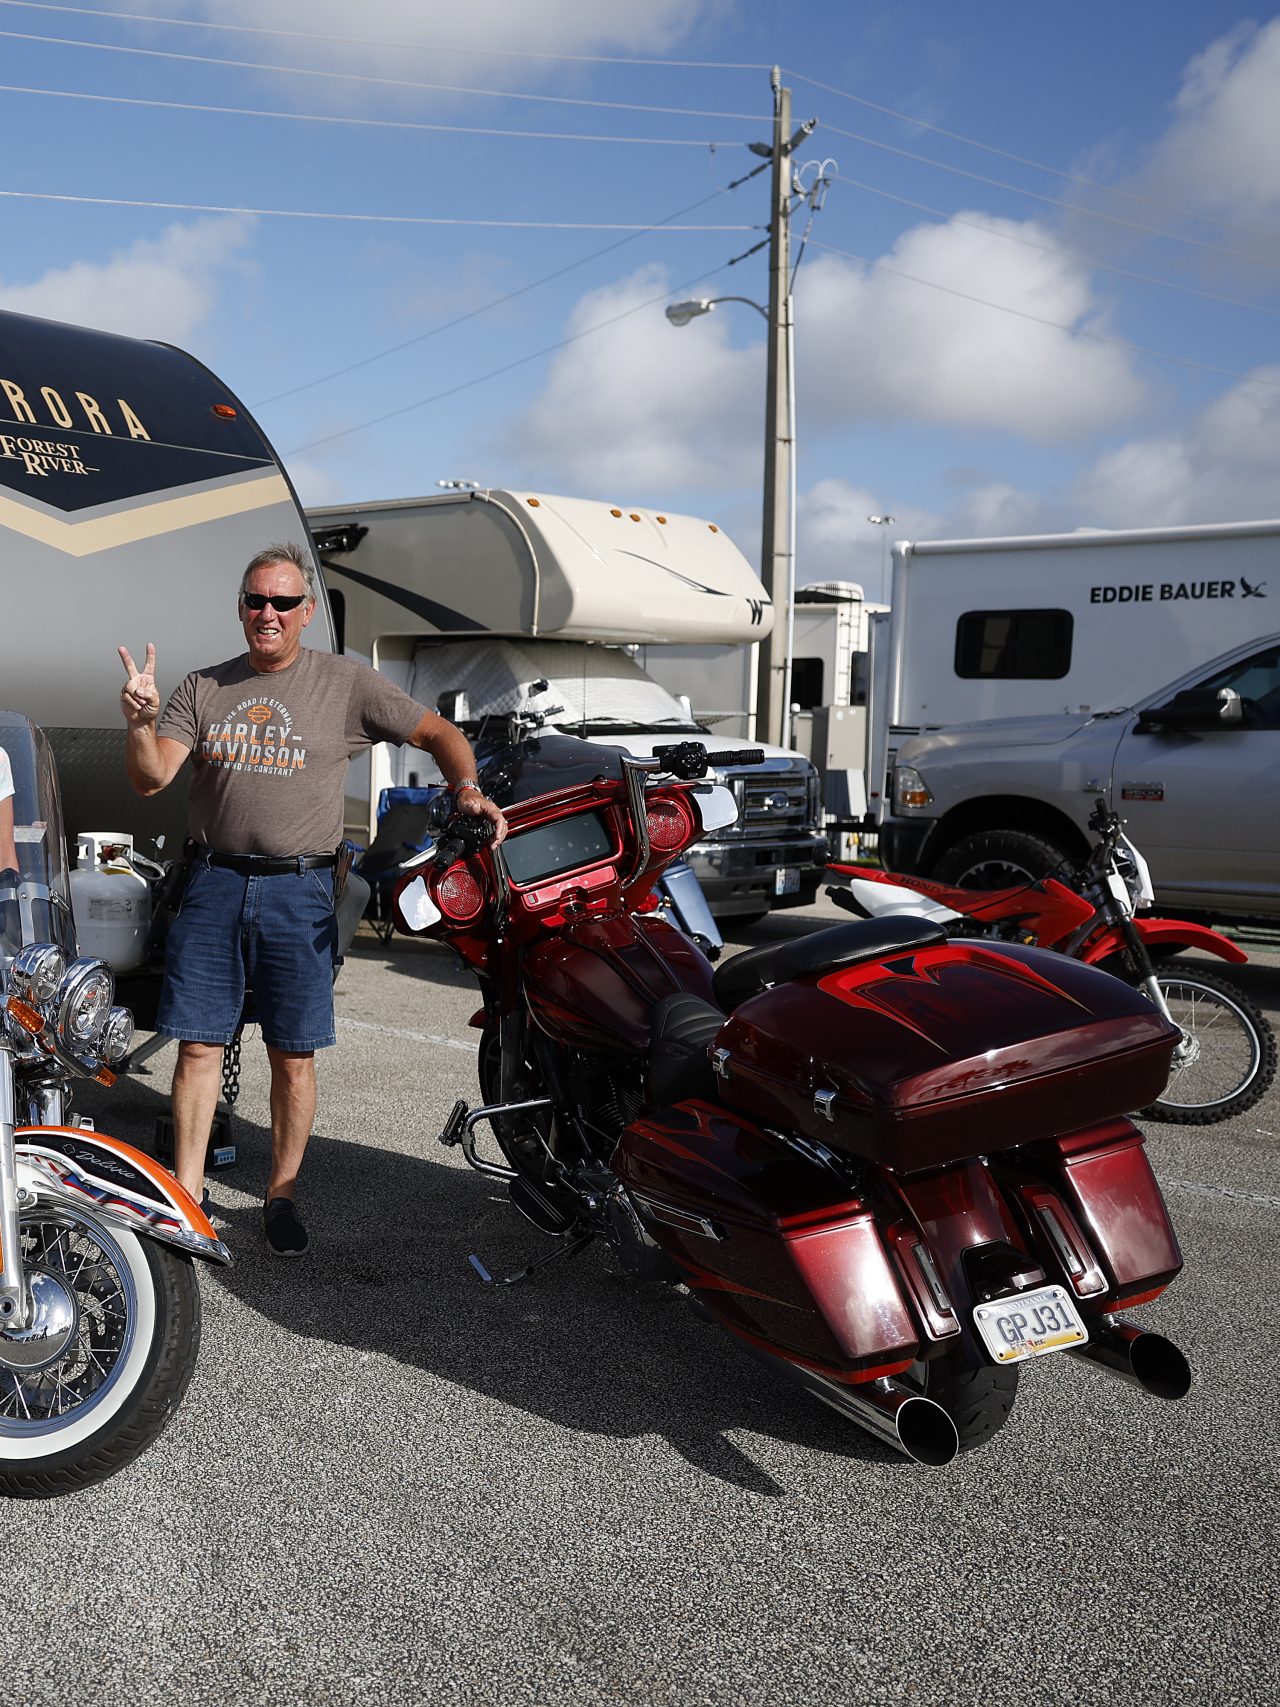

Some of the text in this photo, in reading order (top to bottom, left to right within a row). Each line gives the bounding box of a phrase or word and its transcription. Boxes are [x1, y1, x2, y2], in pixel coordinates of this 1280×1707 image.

[19, 452, 89, 477] RIVER
[1090, 580, 1236, 604] EDDIE BAUER
[223, 696, 294, 728] THE ROAD IS ETERNAL
[202, 741, 306, 770] DAVIDSON
[244, 763, 253, 772] IS
[253, 764, 295, 777] CONSTANT
[901, 875, 948, 893] HOND
[75, 1150, 137, 1179] Deluxe
[996, 1302, 1076, 1344] GPJ31
